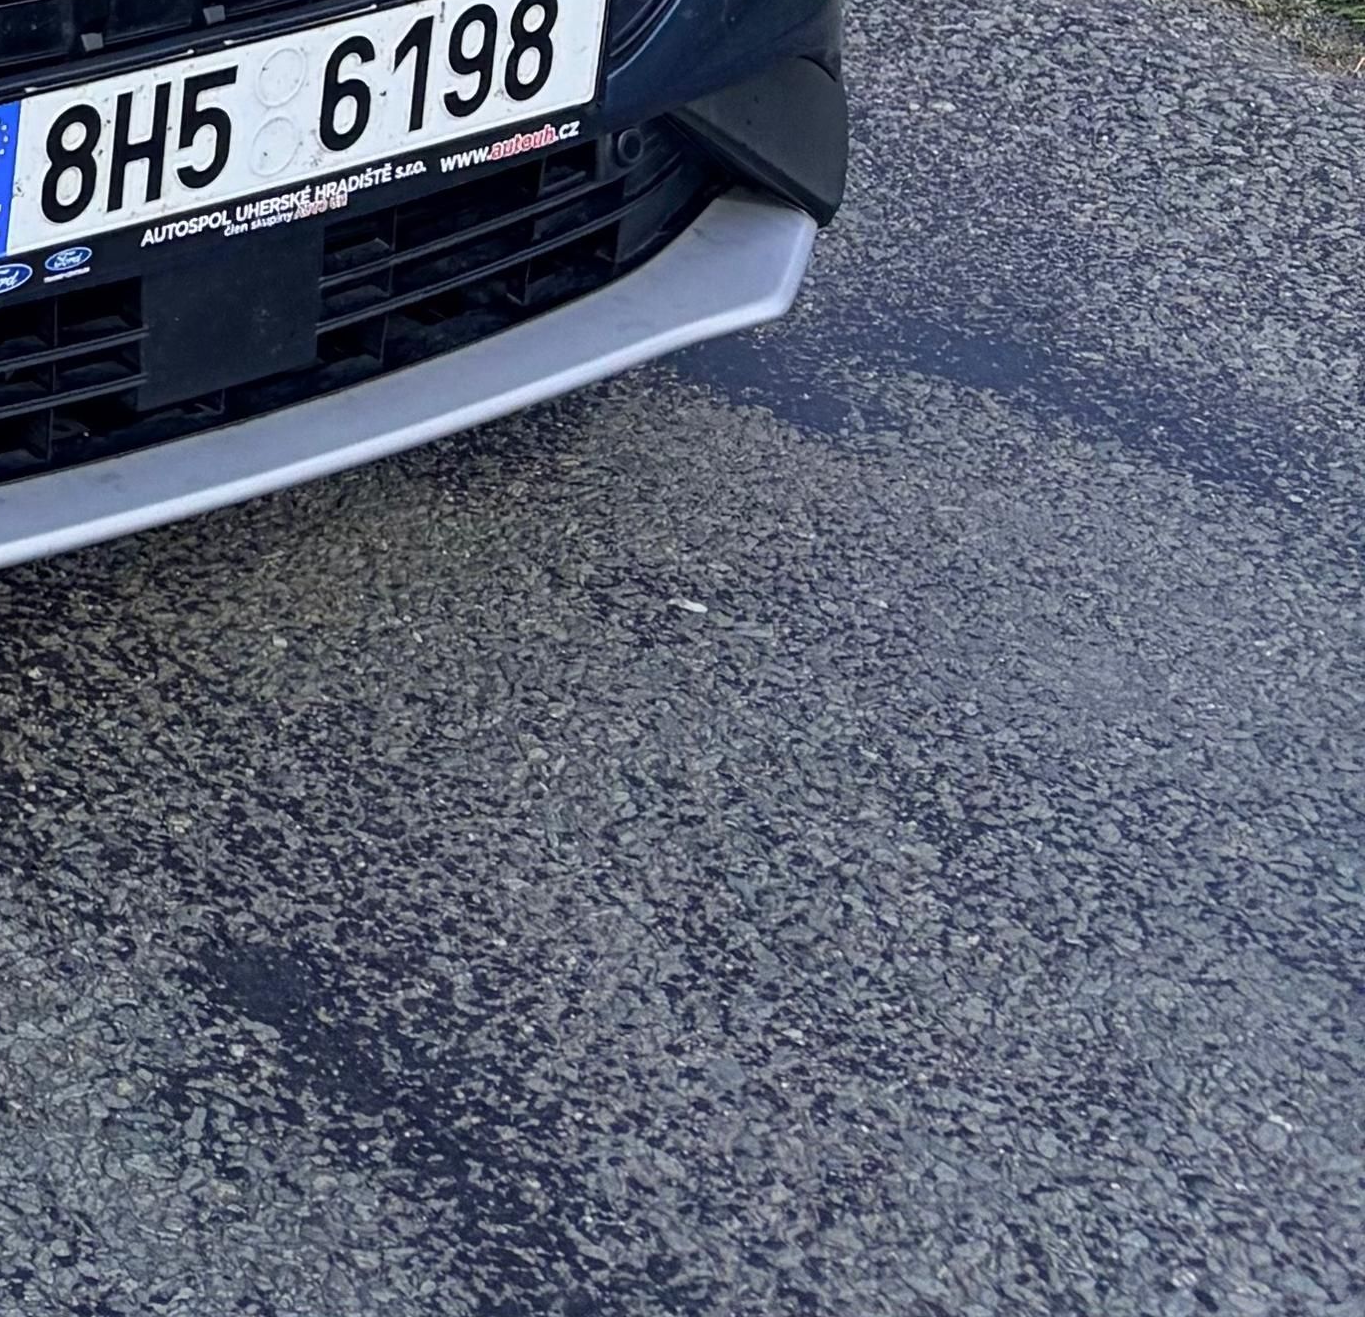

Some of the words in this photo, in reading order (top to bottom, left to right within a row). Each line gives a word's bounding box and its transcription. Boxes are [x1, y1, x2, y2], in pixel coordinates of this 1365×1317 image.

[40, 65, 239, 224] 8H5
[140, 210, 232, 248] AUTOSPOL
[235, 185, 311, 222] UHERSKÉ
[314, 163, 393, 201] HRADIŠTĚ
